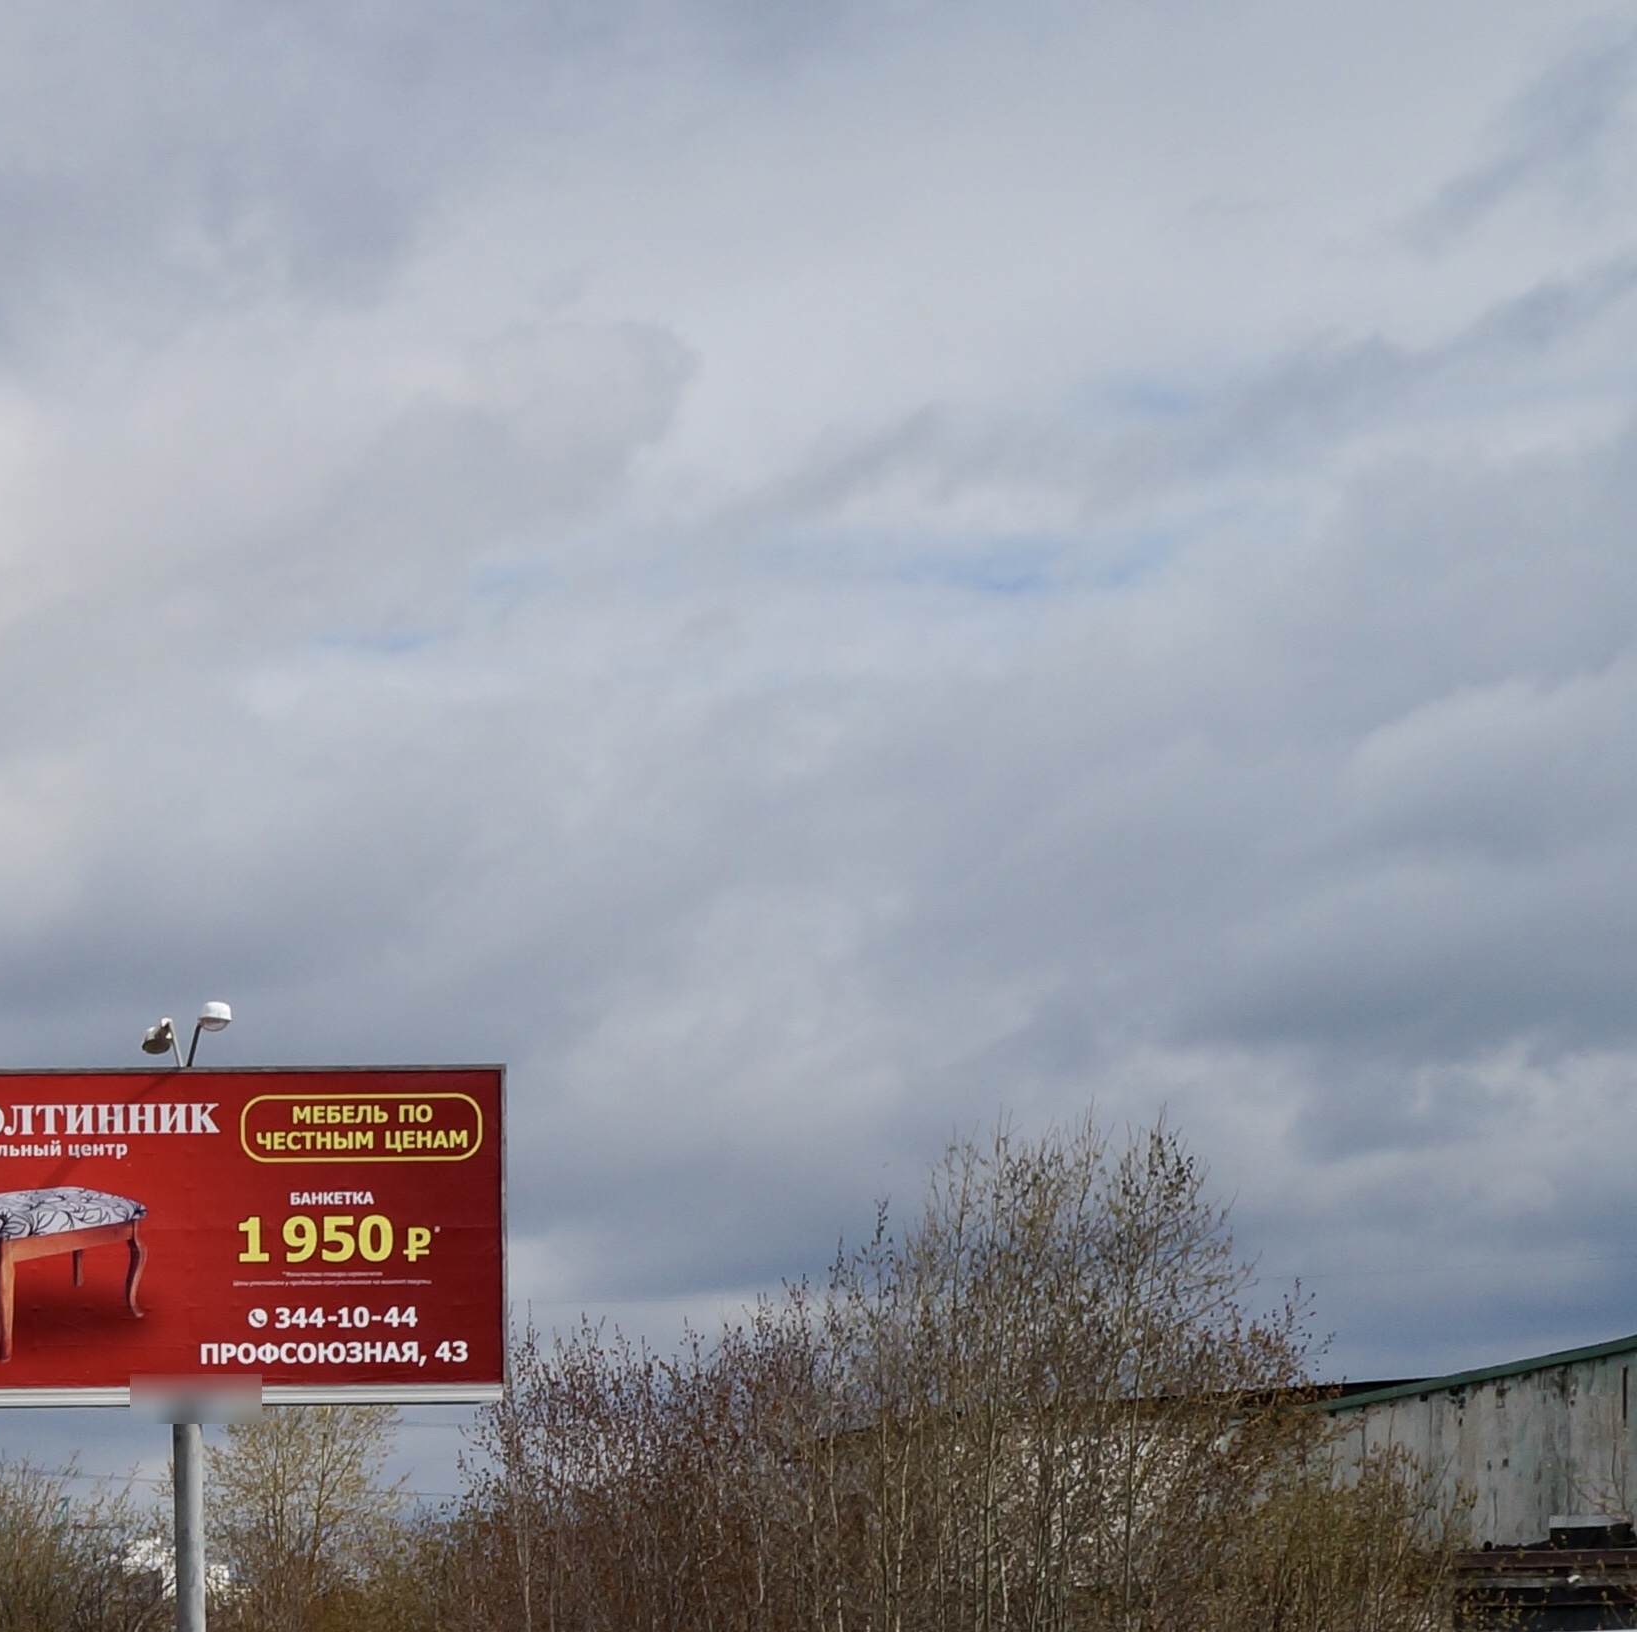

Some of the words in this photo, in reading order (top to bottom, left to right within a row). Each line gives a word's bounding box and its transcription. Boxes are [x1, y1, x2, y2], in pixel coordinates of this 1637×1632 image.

[292, 1105, 389, 1125] МЕБЕЛЬ
[398, 1104, 433, 1124] ПО
[68, 1143, 128, 1159] центр
[256, 1131, 374, 1151] ЧЕСТНЫМ
[385, 1130, 468, 1152] ЦЕНАМ
[290, 1191, 374, 1206] БАНКЕТКА
[275, 1306, 418, 1329] 344-10-44
[200, 1341, 427, 1367] ПРОФСОЮЗНАЯ,
[434, 1341, 468, 1362] 43
